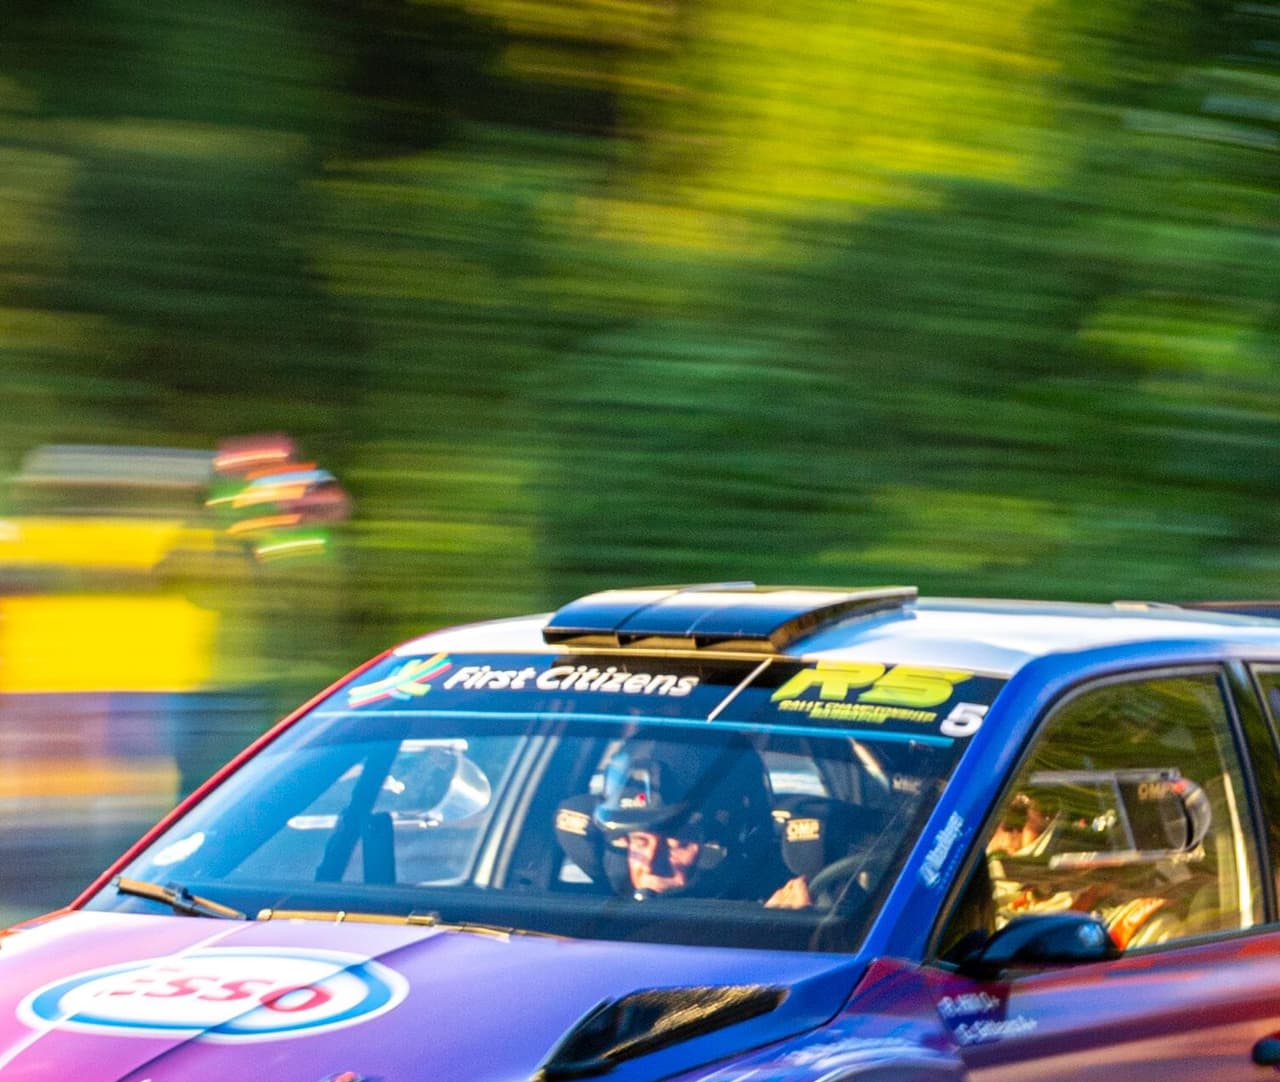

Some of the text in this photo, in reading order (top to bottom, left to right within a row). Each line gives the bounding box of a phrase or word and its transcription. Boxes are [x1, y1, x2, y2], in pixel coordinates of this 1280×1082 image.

[443, 664, 700, 697] First Citizens
[939, 701, 990, 738] 5
